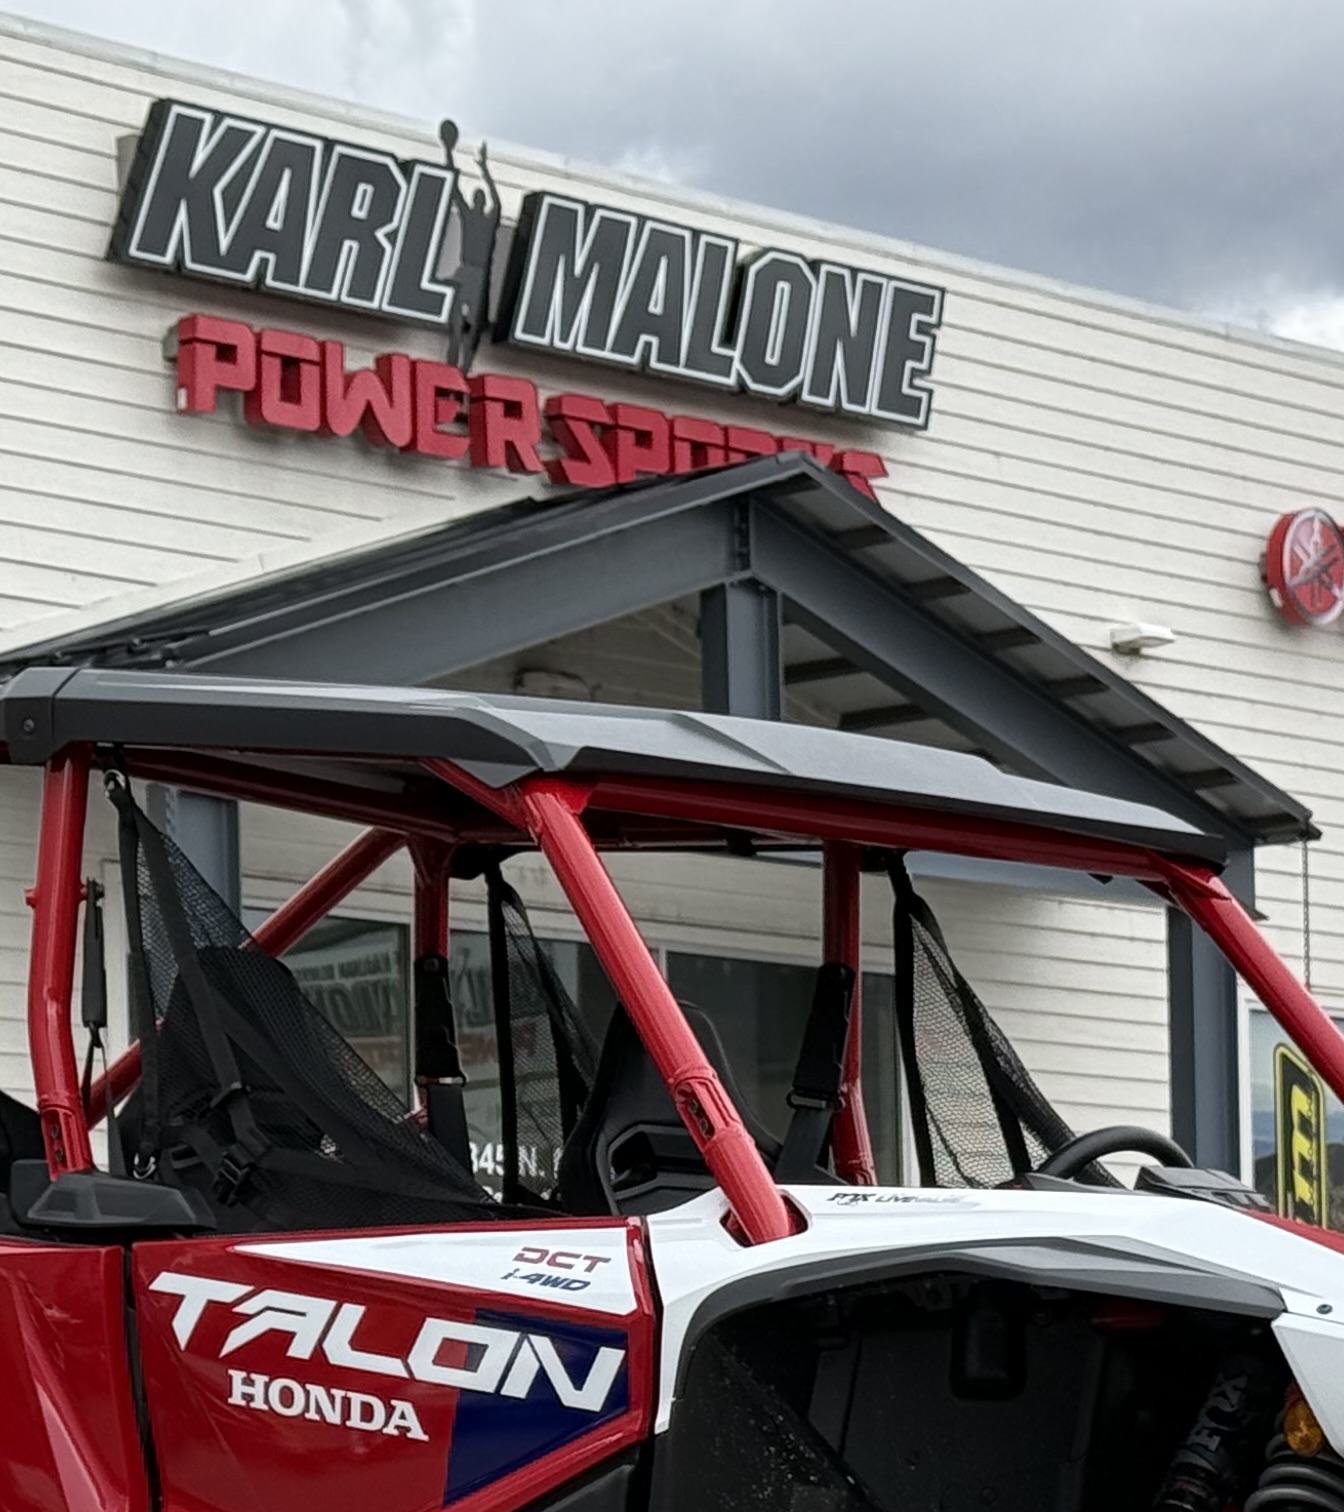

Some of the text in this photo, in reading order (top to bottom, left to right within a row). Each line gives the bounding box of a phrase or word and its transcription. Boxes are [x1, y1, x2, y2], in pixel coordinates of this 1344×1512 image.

[109, 98, 945, 430] KARL MALONE
[500, 1268, 591, 1291] i-4WD
[512, 1247, 611, 1273] DCT
[148, 1271, 626, 1412] TALON
[228, 1370, 429, 1441] HONDA
